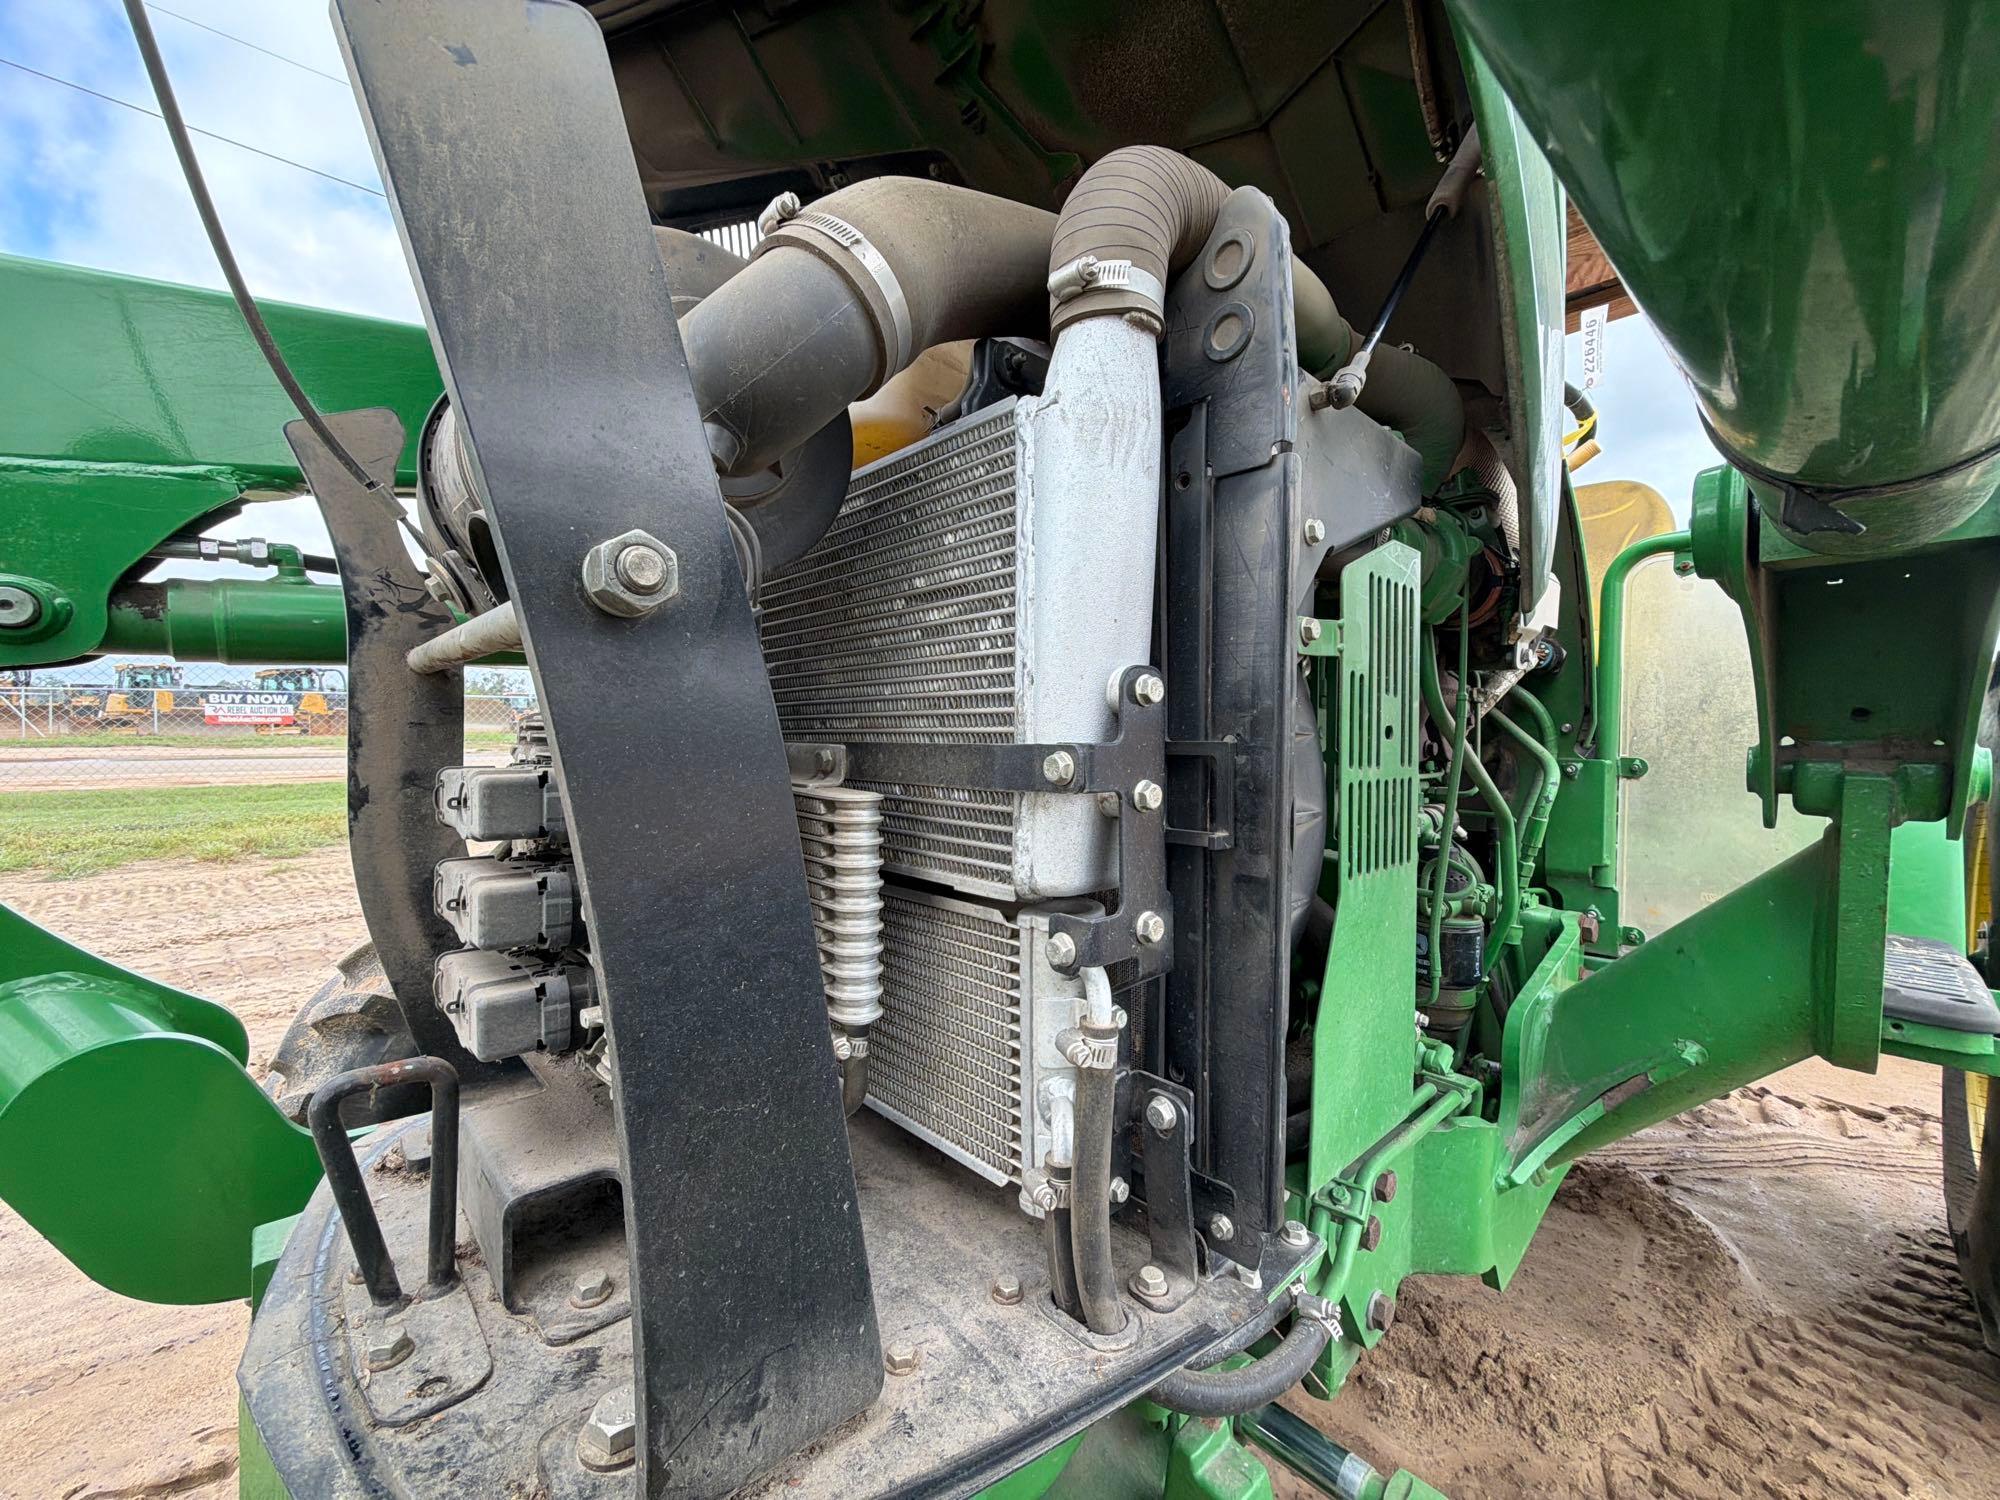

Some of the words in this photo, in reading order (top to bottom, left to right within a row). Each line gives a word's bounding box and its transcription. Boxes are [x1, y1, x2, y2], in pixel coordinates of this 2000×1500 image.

[1584, 319, 1597, 375] 226446
[208, 693, 242, 703] BUY
[246, 693, 288, 703] NOW
[227, 706, 247, 714] REBEL
[249, 706, 277, 714] AUCTION
